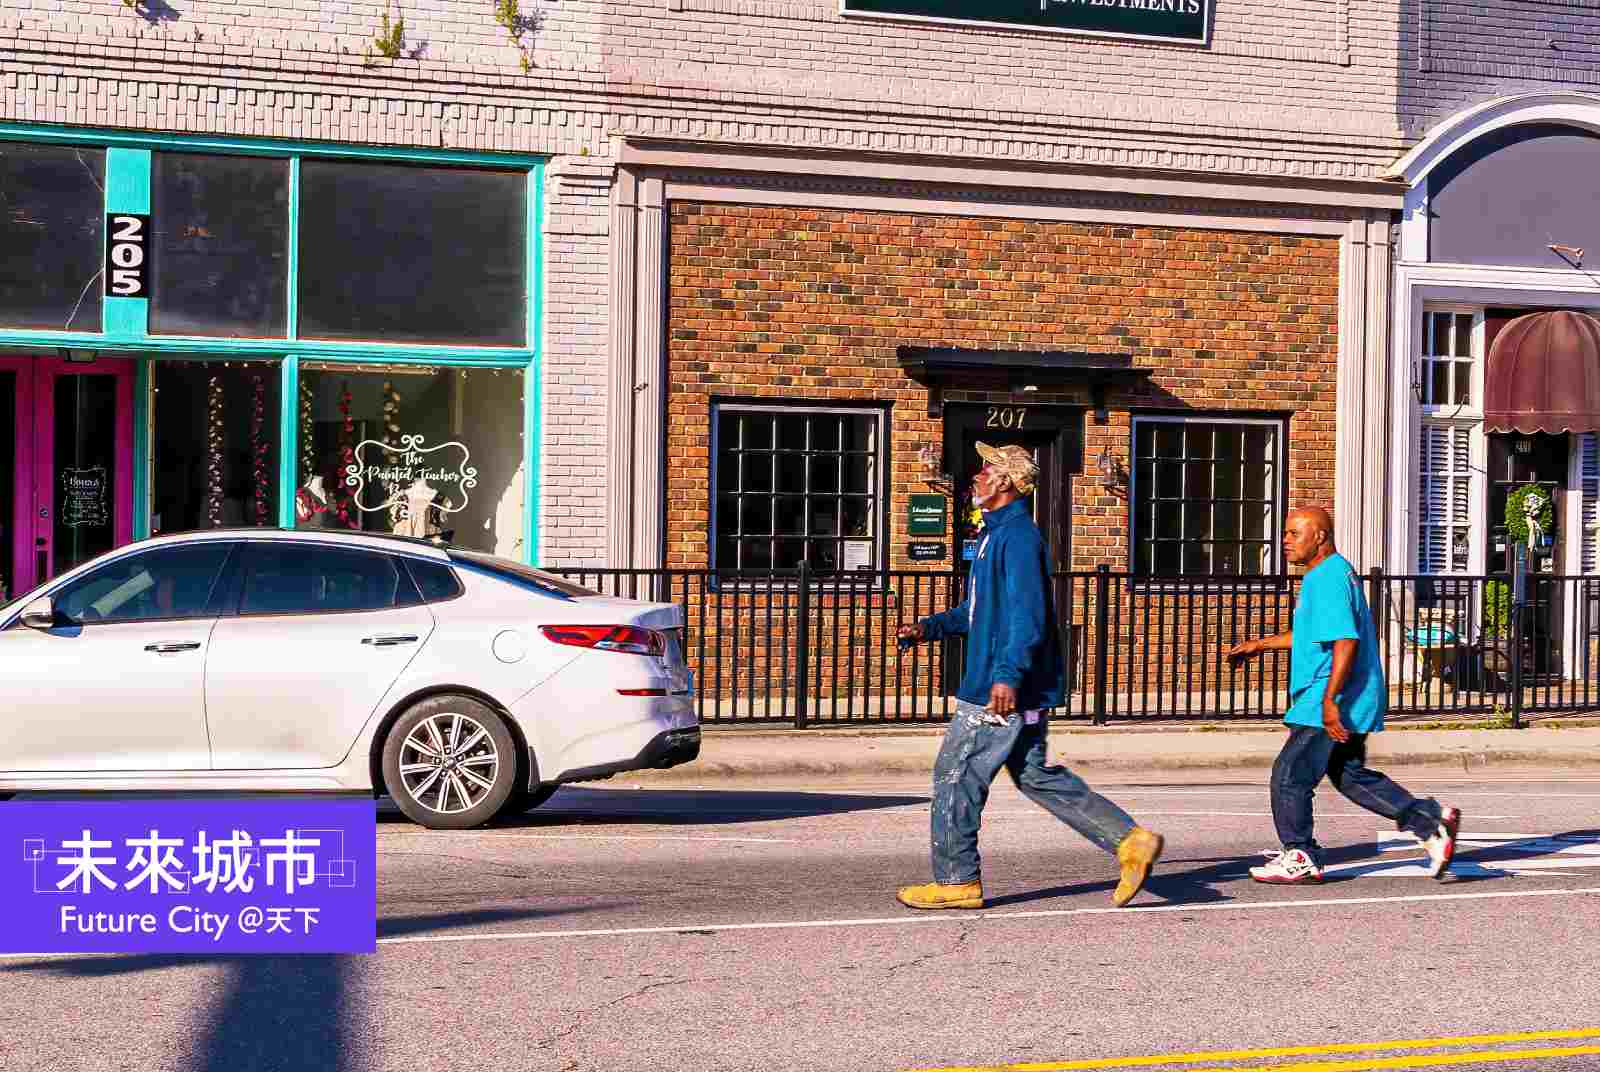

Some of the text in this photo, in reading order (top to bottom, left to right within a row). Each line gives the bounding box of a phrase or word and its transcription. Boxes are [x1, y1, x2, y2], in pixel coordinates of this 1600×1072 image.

[1051, 0, 1200, 14] TMENTS
[111, 216, 144, 295] 205
[986, 407, 1027, 429] 207
